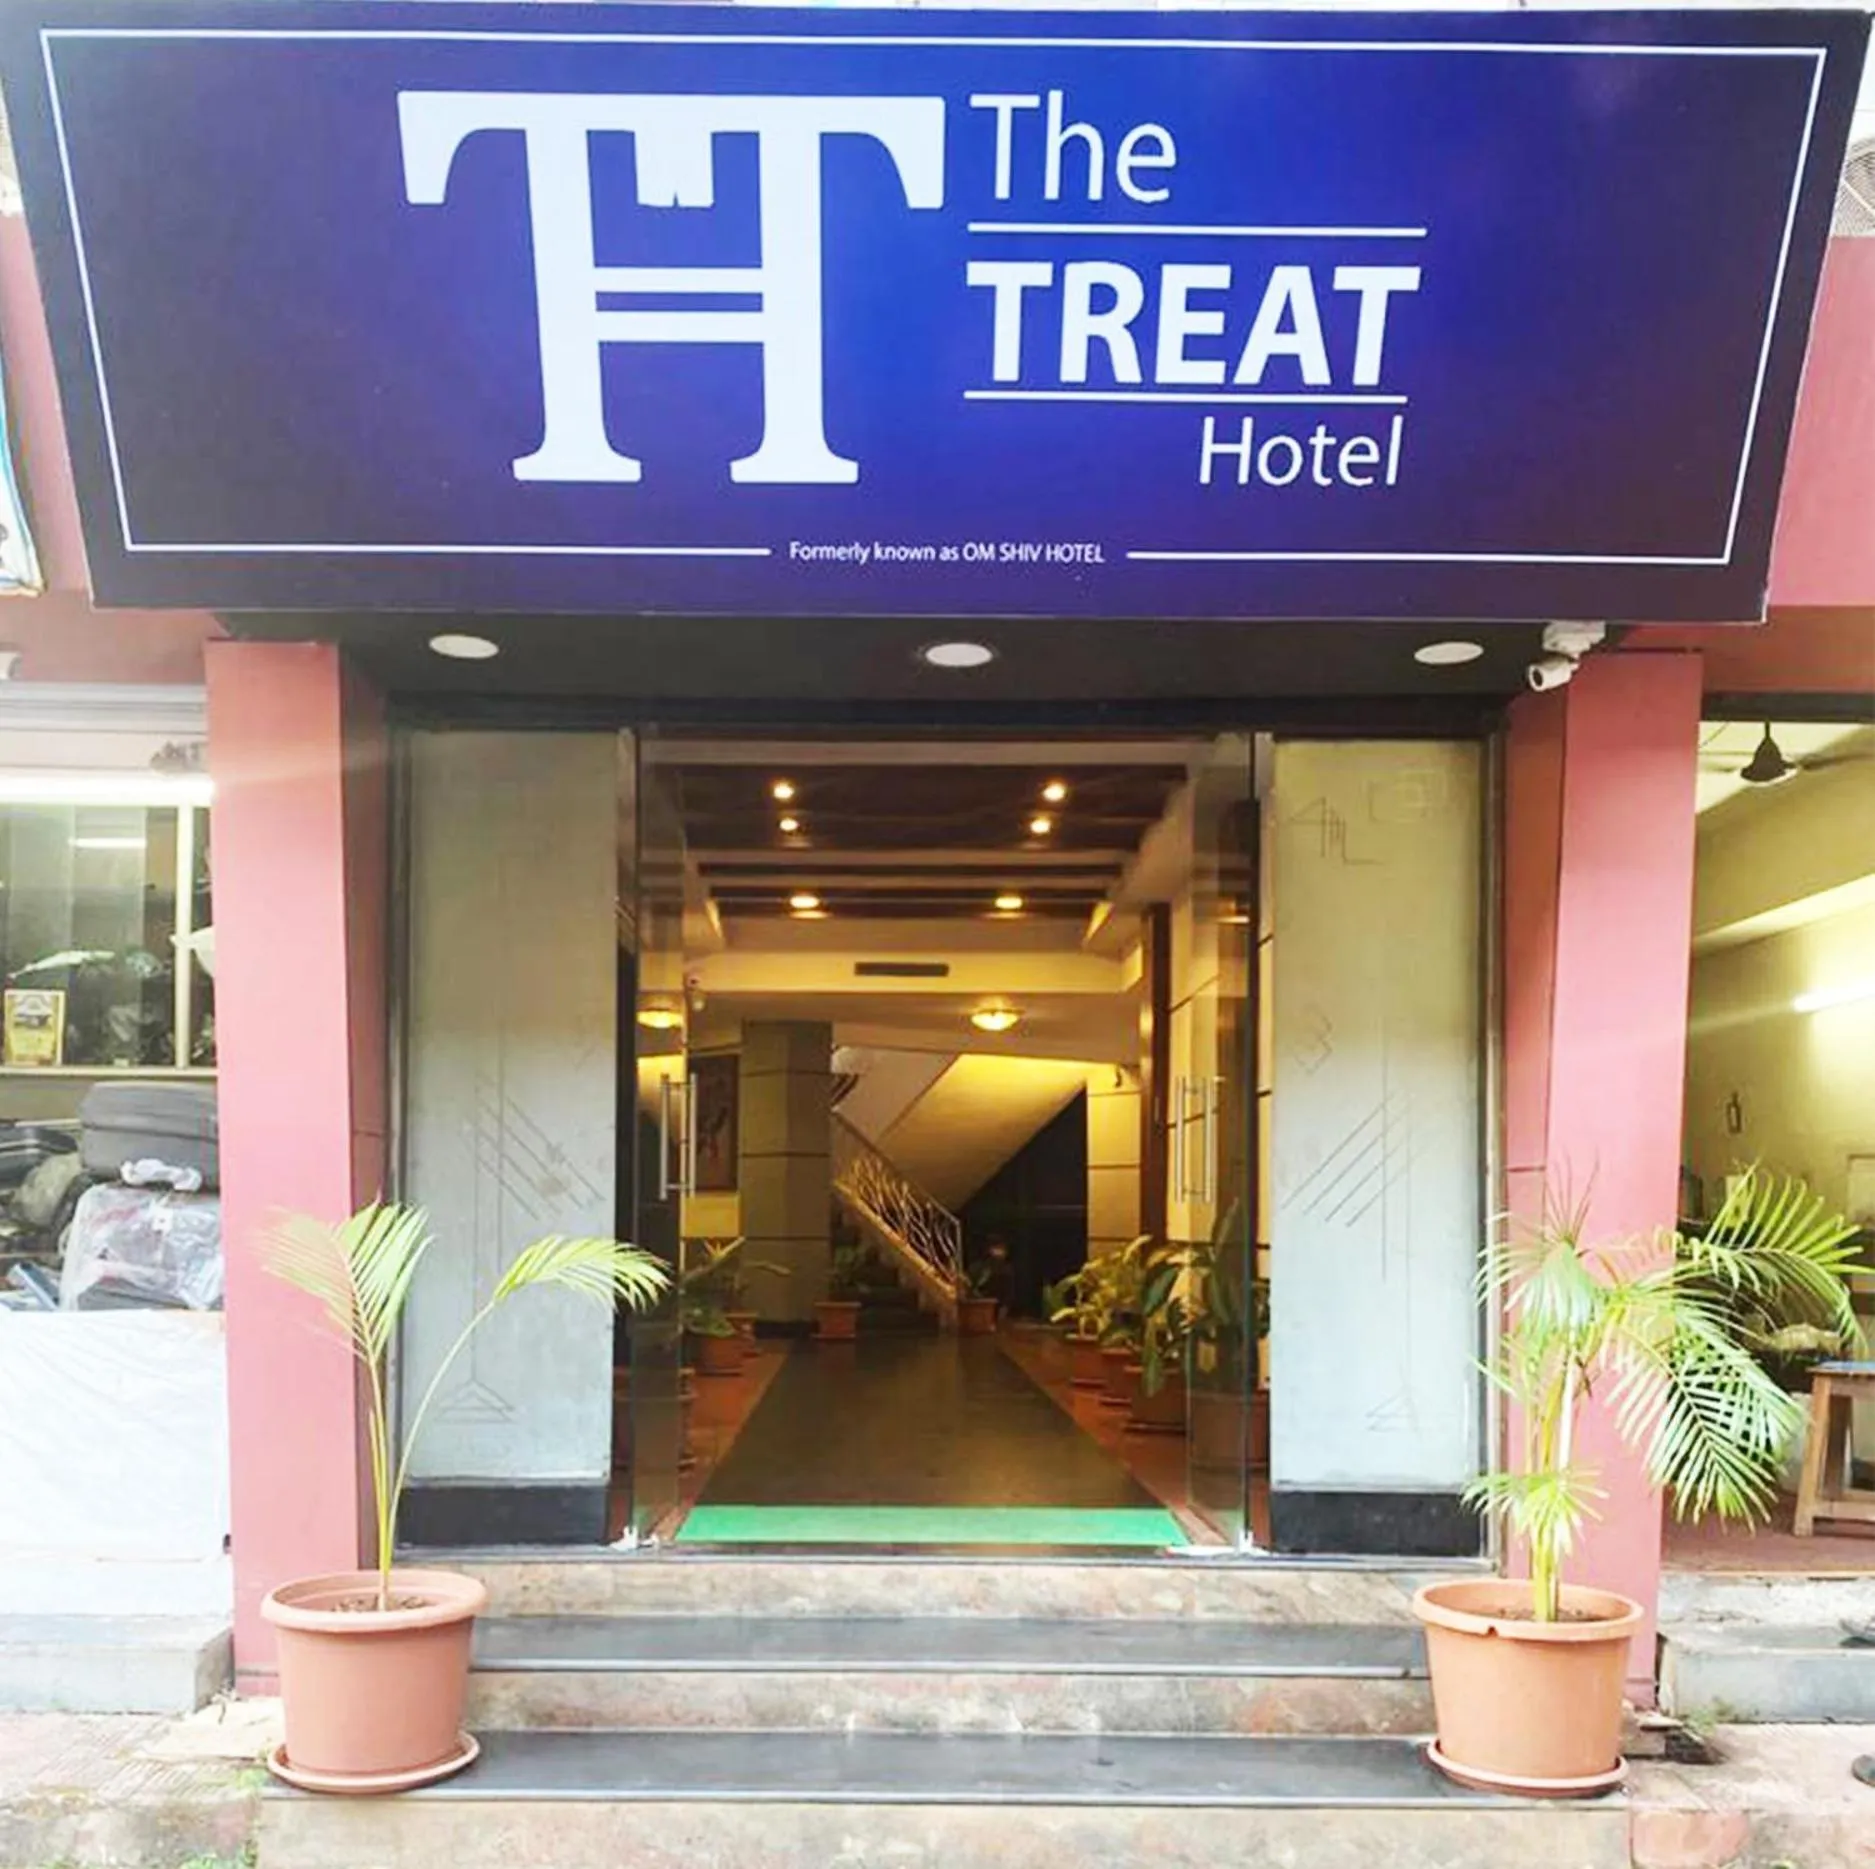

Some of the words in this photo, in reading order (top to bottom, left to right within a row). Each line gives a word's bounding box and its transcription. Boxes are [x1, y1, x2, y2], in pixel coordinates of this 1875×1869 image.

[970, 90, 1177, 204] The
[966, 261, 1421, 386] TREAT
[1199, 415, 1404, 487] Hotel
[789, 541, 871, 565] Formerly
[873, 541, 936, 561] known
[939, 546, 959, 561] as
[962, 542, 995, 562] OM
[999, 543, 1043, 562] SHIV
[1045, 543, 1105, 564] HOTEL
